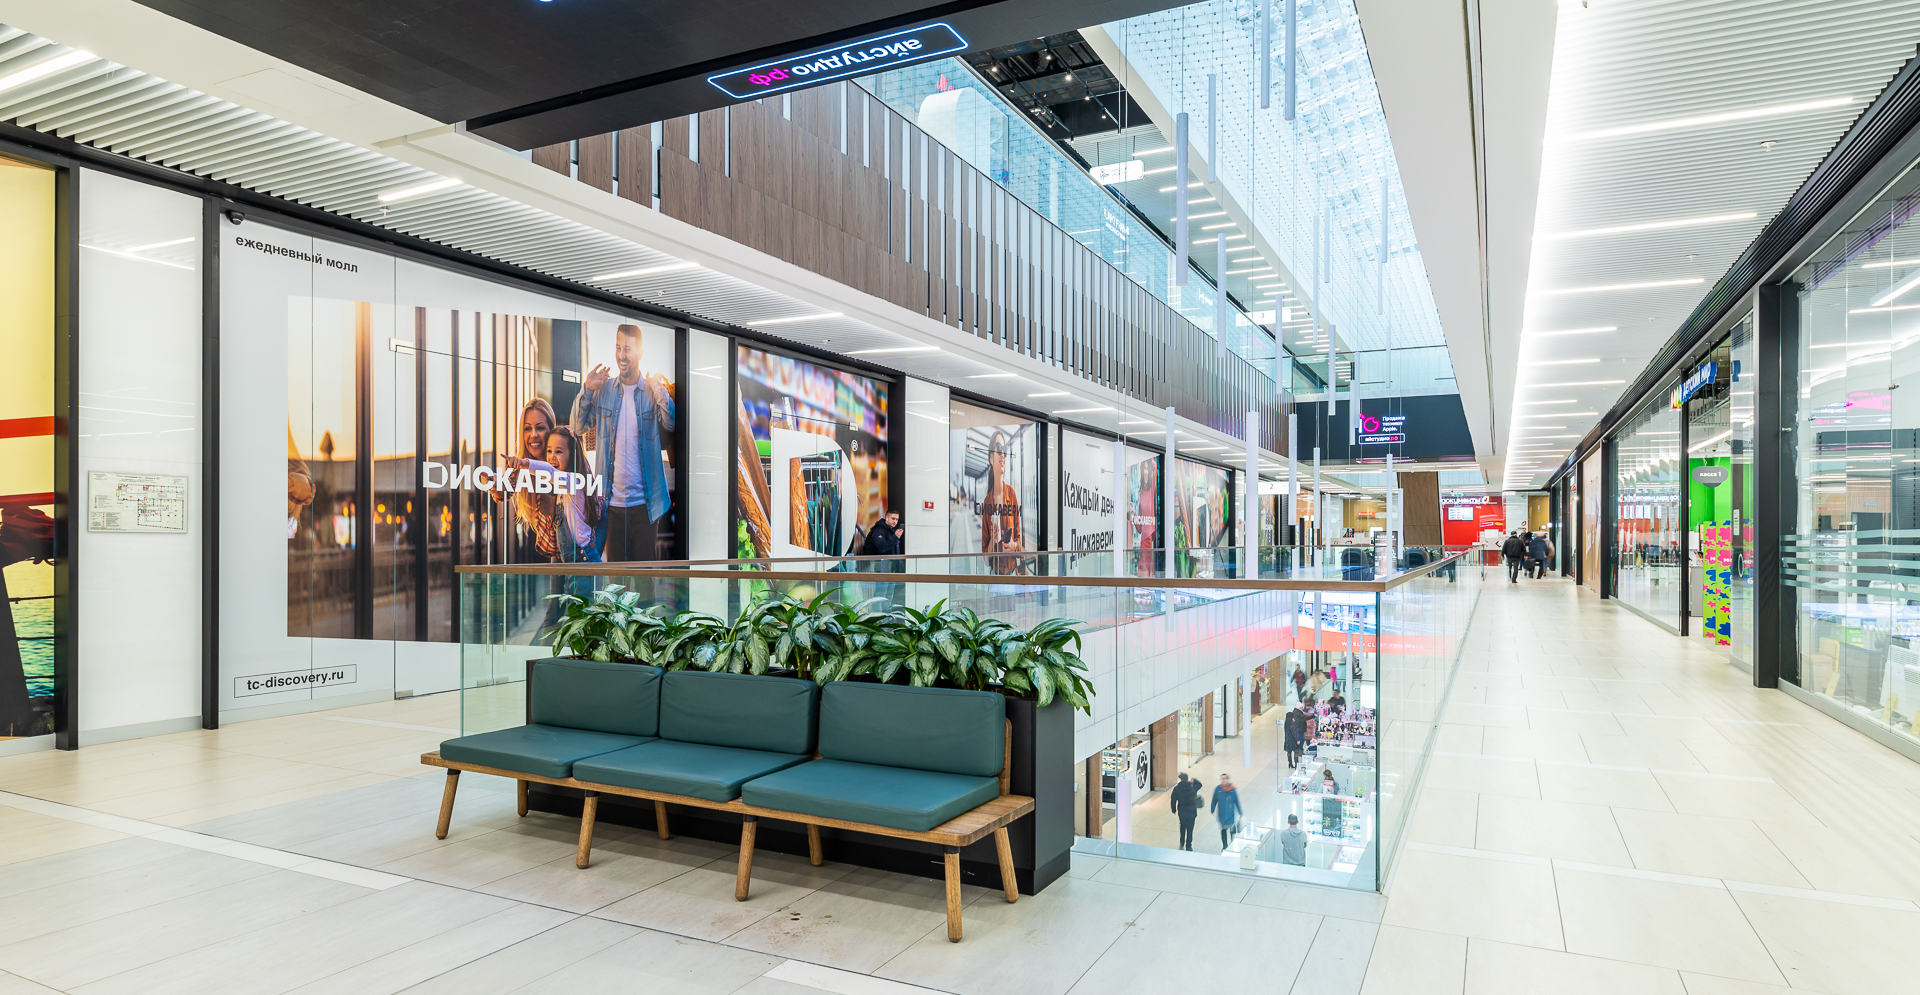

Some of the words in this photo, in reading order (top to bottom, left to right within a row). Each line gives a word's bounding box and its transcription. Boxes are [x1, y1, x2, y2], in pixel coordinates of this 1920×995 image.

[748, 38, 923, 87] айстудио.рф
[235, 236, 323, 265] ежедневный
[326, 258, 358, 273] молл
[1063, 470, 1099, 516] Каждый
[1100, 494, 1115, 518] ден
[246, 670, 344, 690] tc-discovery.ru
